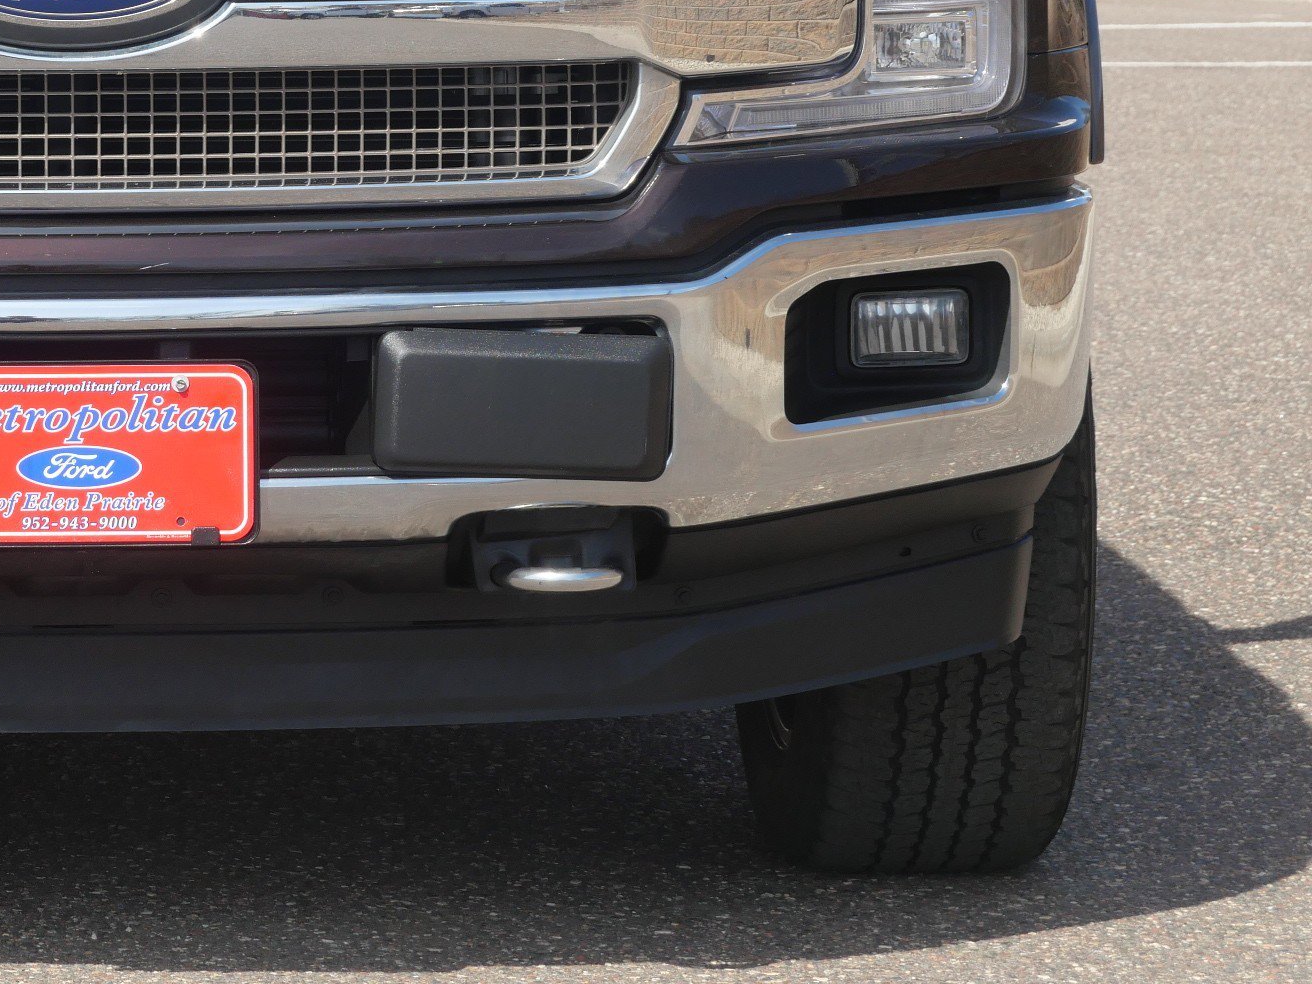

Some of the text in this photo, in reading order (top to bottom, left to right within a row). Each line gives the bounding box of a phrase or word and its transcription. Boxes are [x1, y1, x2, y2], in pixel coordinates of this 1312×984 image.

[43, 453, 115, 480] Ford
[21, 492, 79, 511] Eden
[82, 491, 166, 511] Prairie
[22, 516, 137, 531] 952-943-9000
